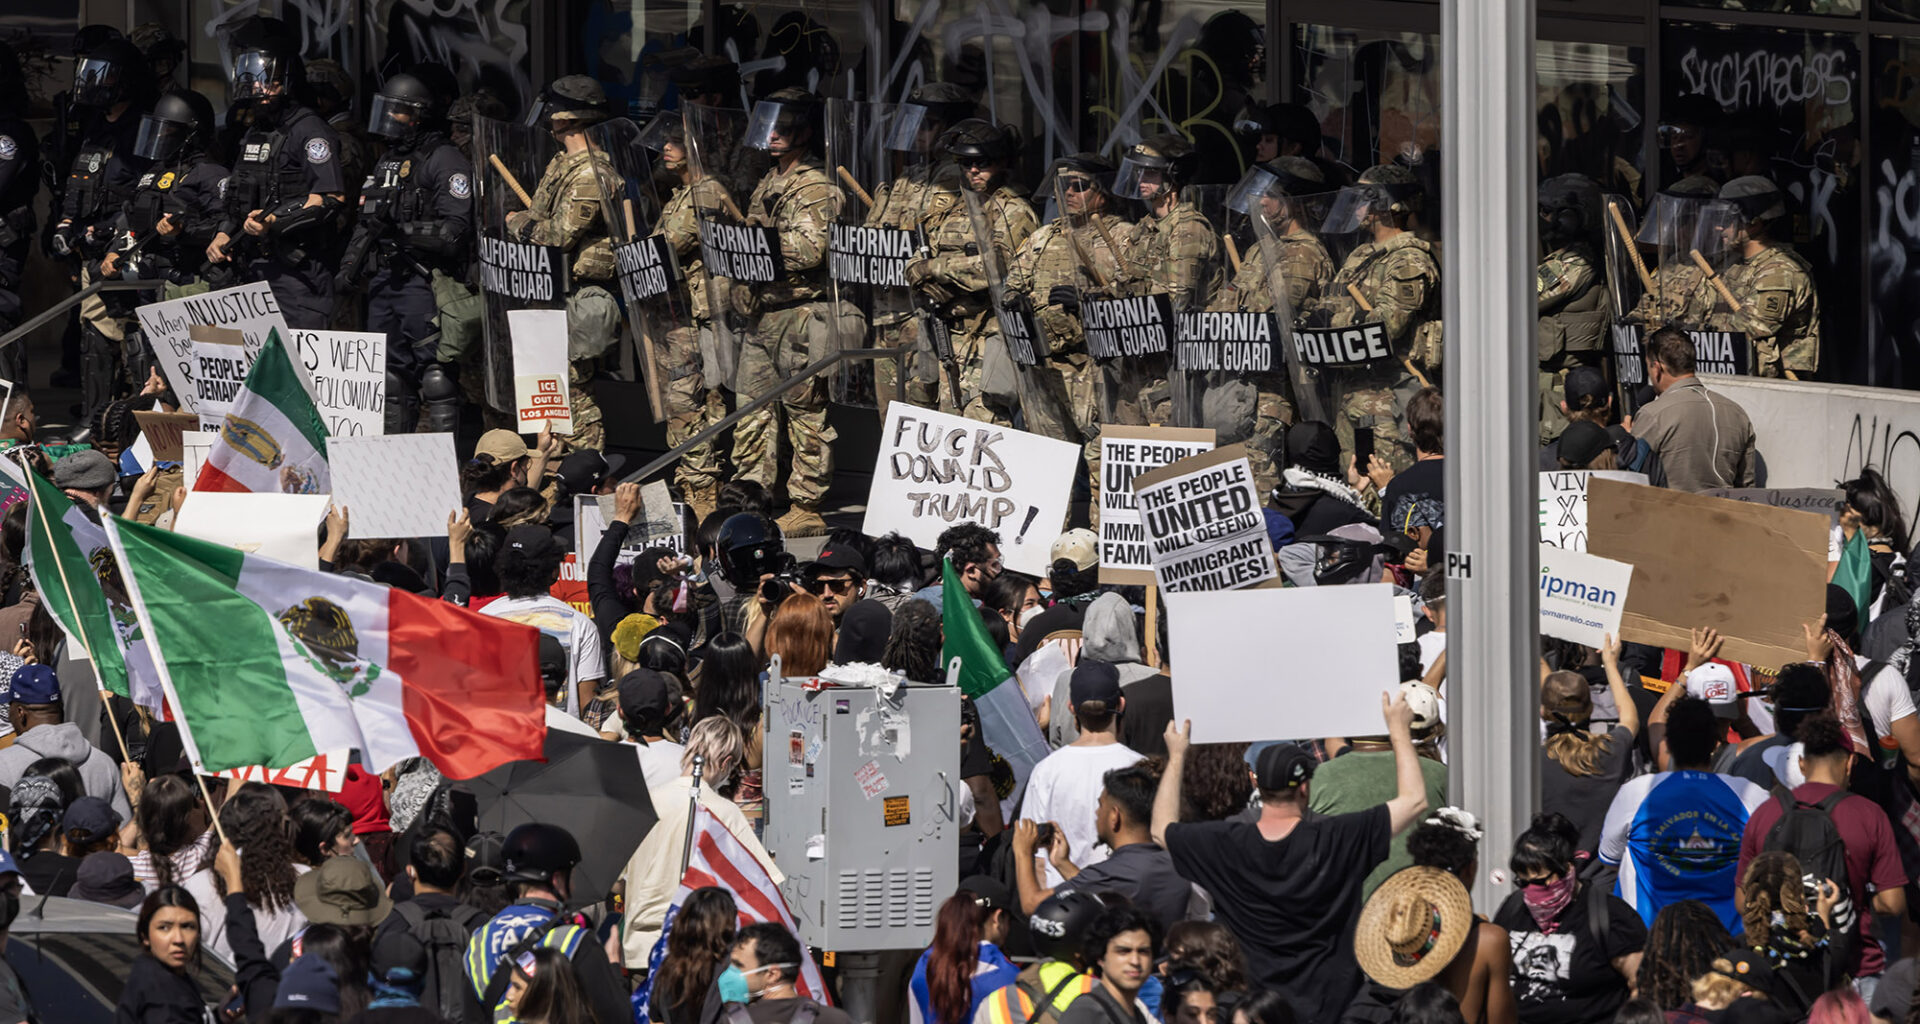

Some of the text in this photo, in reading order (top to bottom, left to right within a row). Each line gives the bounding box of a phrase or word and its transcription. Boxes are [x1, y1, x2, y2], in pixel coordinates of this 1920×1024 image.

[829, 222, 913, 258] CALIFORNIA
[632, 264, 668, 299] GUARD
[732, 253, 775, 281] GUARD
[511, 270, 553, 301] GUARD
[142, 291, 280, 338] When INJUSTICE
[1178, 312, 1271, 342] CALIFORNIA
[329, 337, 384, 376] WERE
[1121, 323, 1167, 356] GUARD
[1292, 326, 1388, 363] POLICE
[200, 357, 246, 381] PEOPLE
[1223, 342, 1271, 372] GUARD
[534, 396, 552, 404] OUT
[540, 382, 557, 391] ICE
[522, 409, 569, 418] LOS ANGELES
[894, 415, 1006, 470] FUCK
[1107, 444, 1136, 462] THE
[890, 452, 1012, 493] DONALD
[1142, 465, 1246, 510] THE PEOPLE
[1147, 485, 1251, 539] UNITED
[1154, 511, 1258, 555] WILL DEFEND
[1161, 538, 1263, 583] IMMIGRANT
[1165, 557, 1270, 592] FAMILIES!
[1448, 553, 1471, 578] PH
[1540, 567, 1616, 606] ipman
[1541, 608, 1604, 629] ipmanrelo.com
[1655, 811, 1699, 836] SALVADOR
